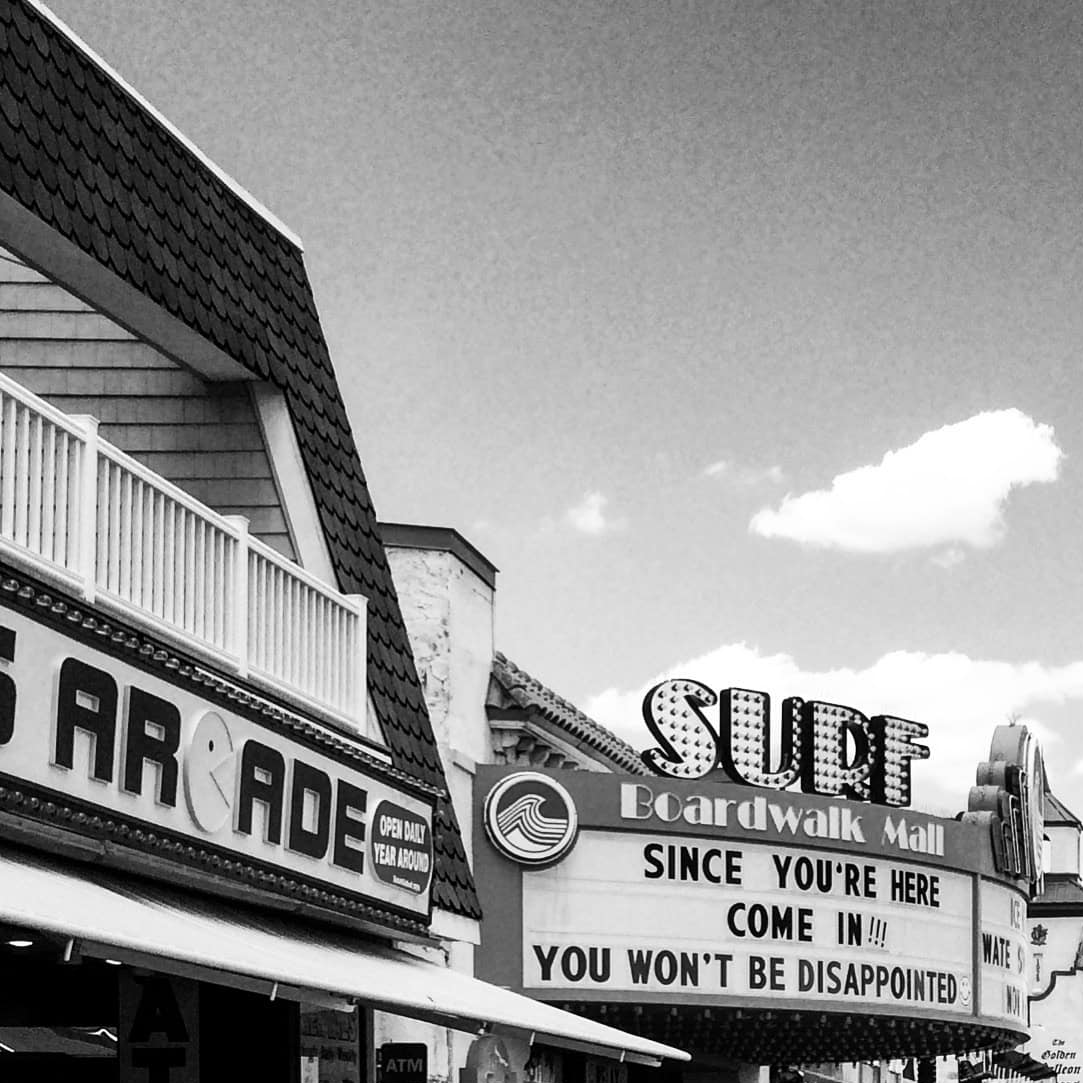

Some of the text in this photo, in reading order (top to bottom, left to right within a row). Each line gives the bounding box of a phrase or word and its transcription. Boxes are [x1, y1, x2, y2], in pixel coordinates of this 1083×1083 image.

[642, 679, 931, 808] SURF
[379, 814, 426, 845] OPEN DAILY
[620, 782, 945, 857] Boardwalk Mall
[374, 842, 430, 873] YEAR AROUND
[643, 842, 940, 909] SINCE YOU'RE HERE
[727, 902, 814, 942] COME
[532, 945, 958, 1006] YOU WON'T BE DISAPPOINTED
[385, 1057, 424, 1073] ATM
[1041, 1050, 1077, 1060] Golden
